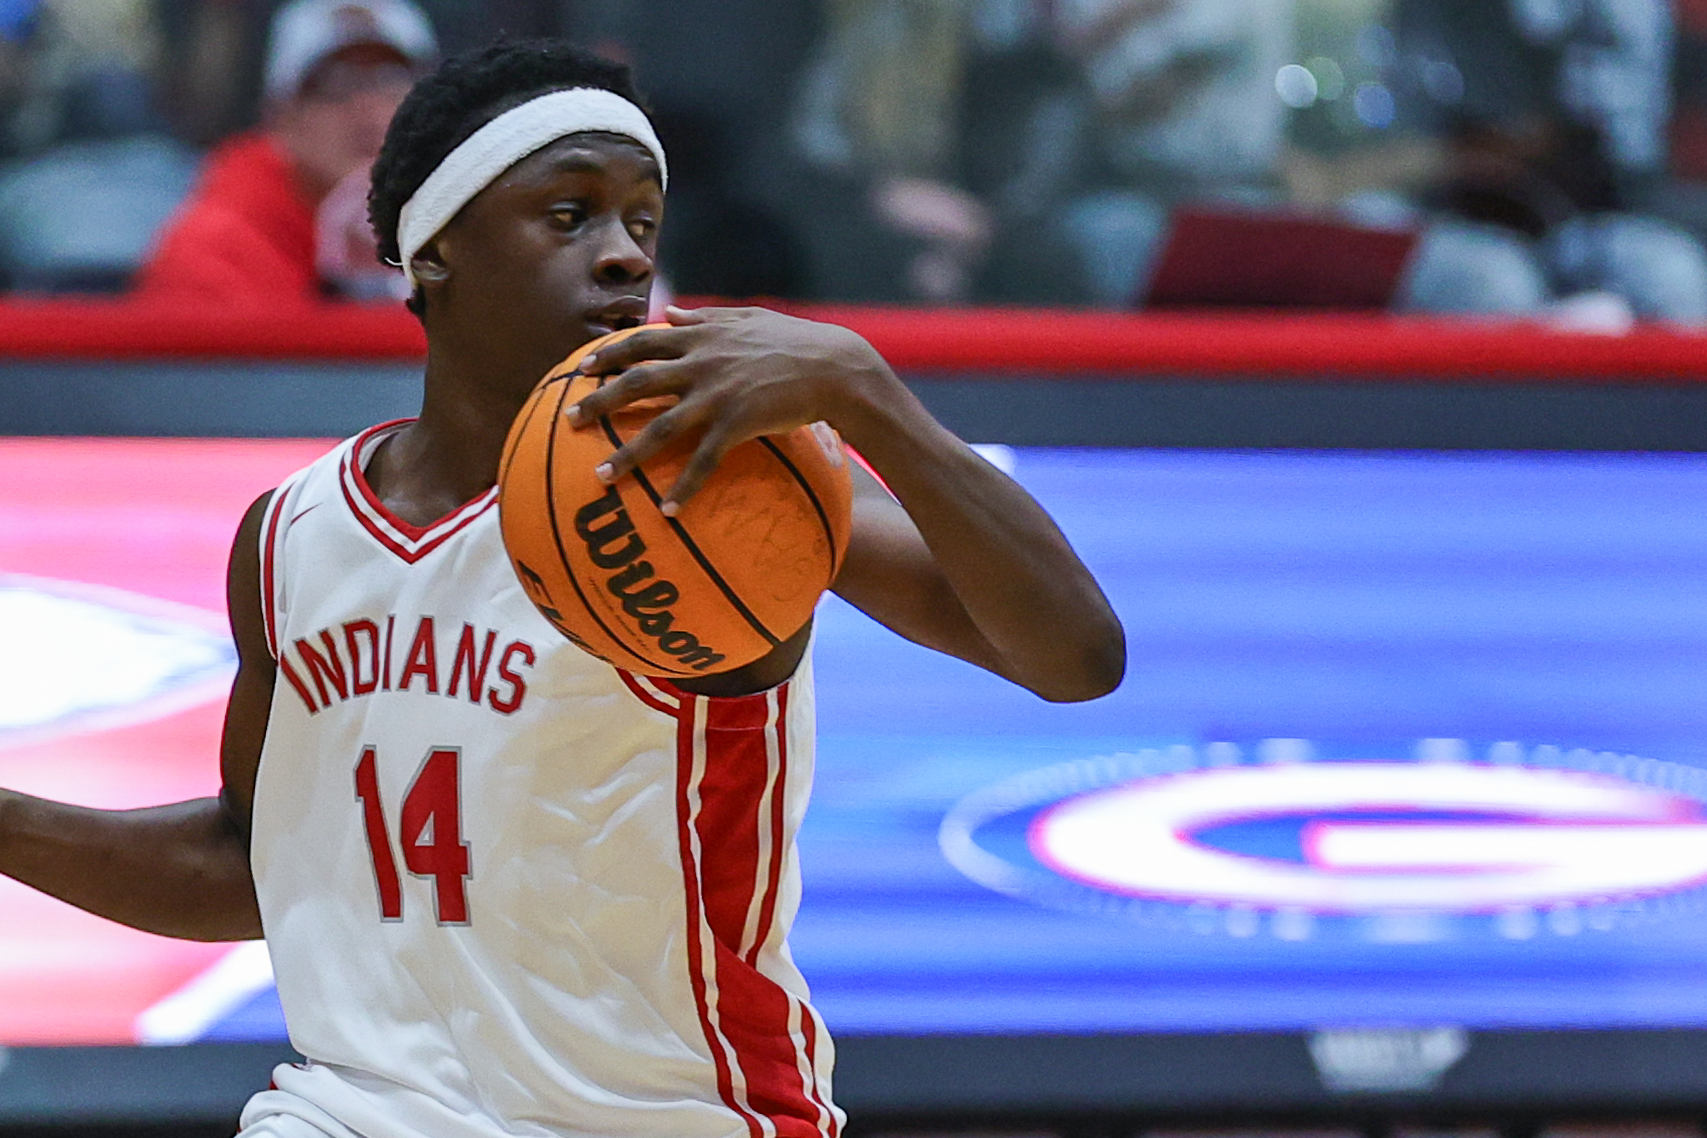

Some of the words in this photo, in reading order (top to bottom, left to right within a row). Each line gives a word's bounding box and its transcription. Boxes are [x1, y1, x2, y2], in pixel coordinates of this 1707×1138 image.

[278, 614, 537, 715] INDIANS
[574, 484, 726, 671] Wilson
[353, 743, 472, 928] 14
